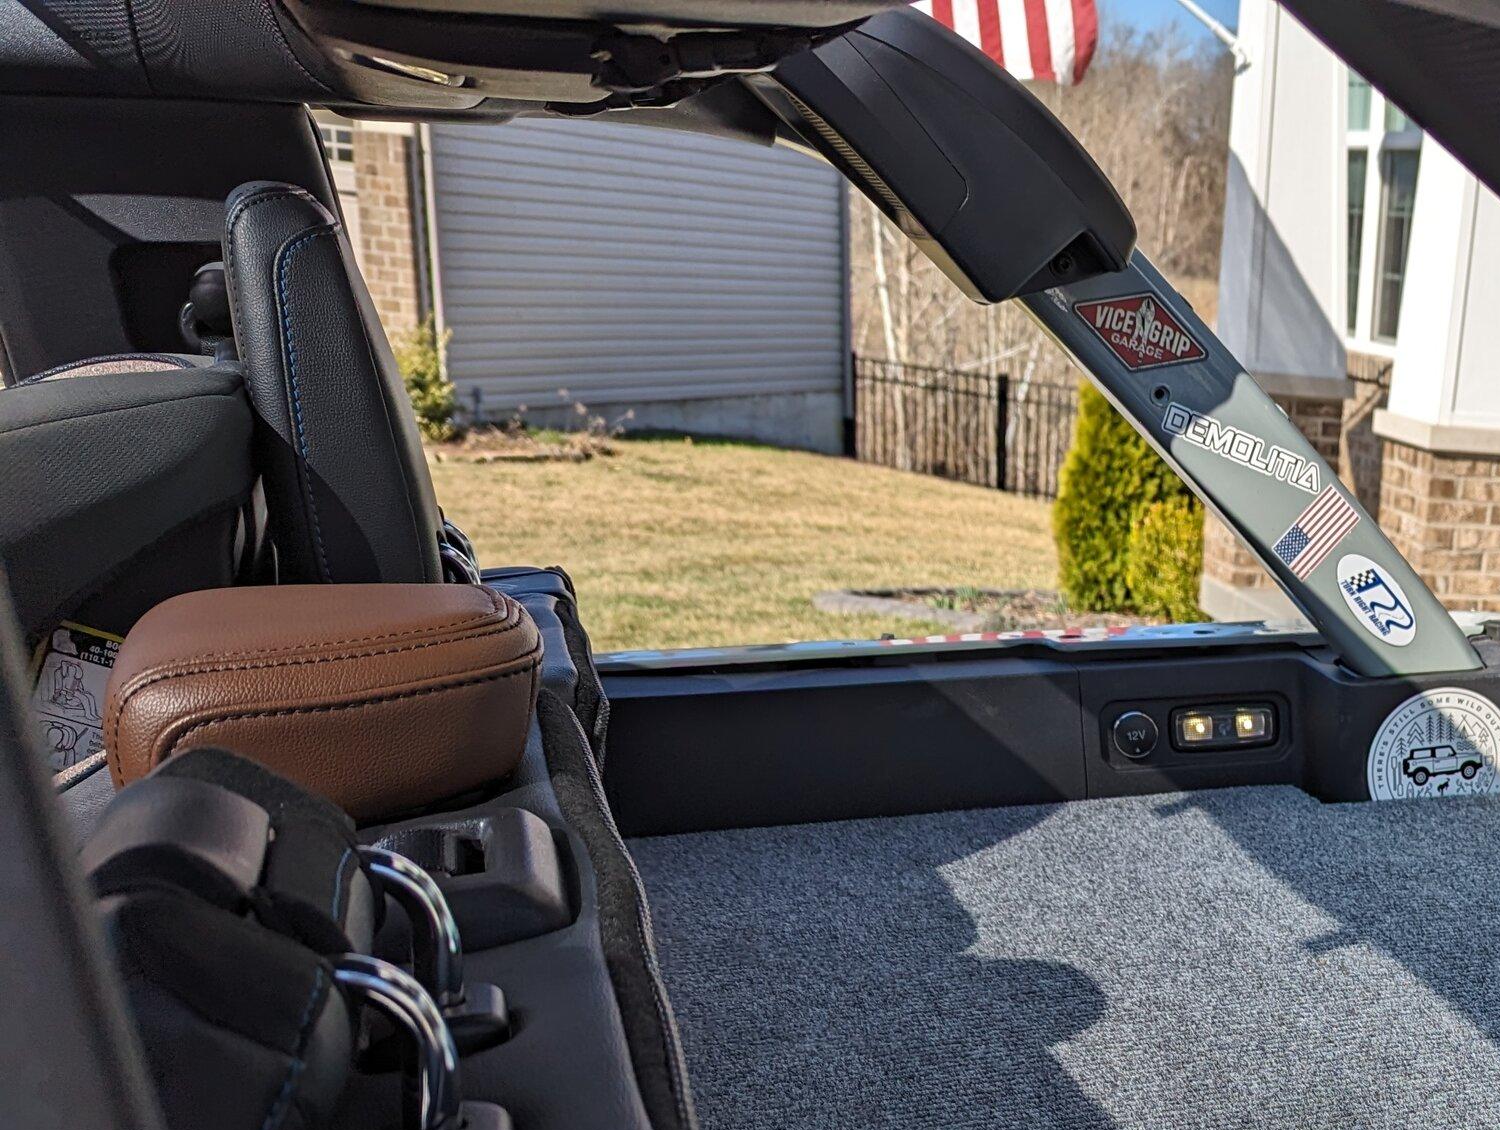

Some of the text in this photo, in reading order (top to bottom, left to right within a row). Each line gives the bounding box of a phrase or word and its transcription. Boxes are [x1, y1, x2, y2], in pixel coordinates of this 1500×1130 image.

[1095, 304, 1191, 357] VICE GRIP
[1111, 333, 1164, 360] GARAGE
[1162, 403, 1321, 493] DEMOLITIA
[1340, 579, 1392, 636] TURN RIGHT RACING
[1126, 729, 1146, 741] 12V
[1377, 740, 1389, 790] THERE'S
[1388, 708, 1416, 735] STILL
[1420, 696, 1450, 709] SOME
[1457, 697, 1482, 713] WILD
[1485, 712, 1500, 733] OUT
